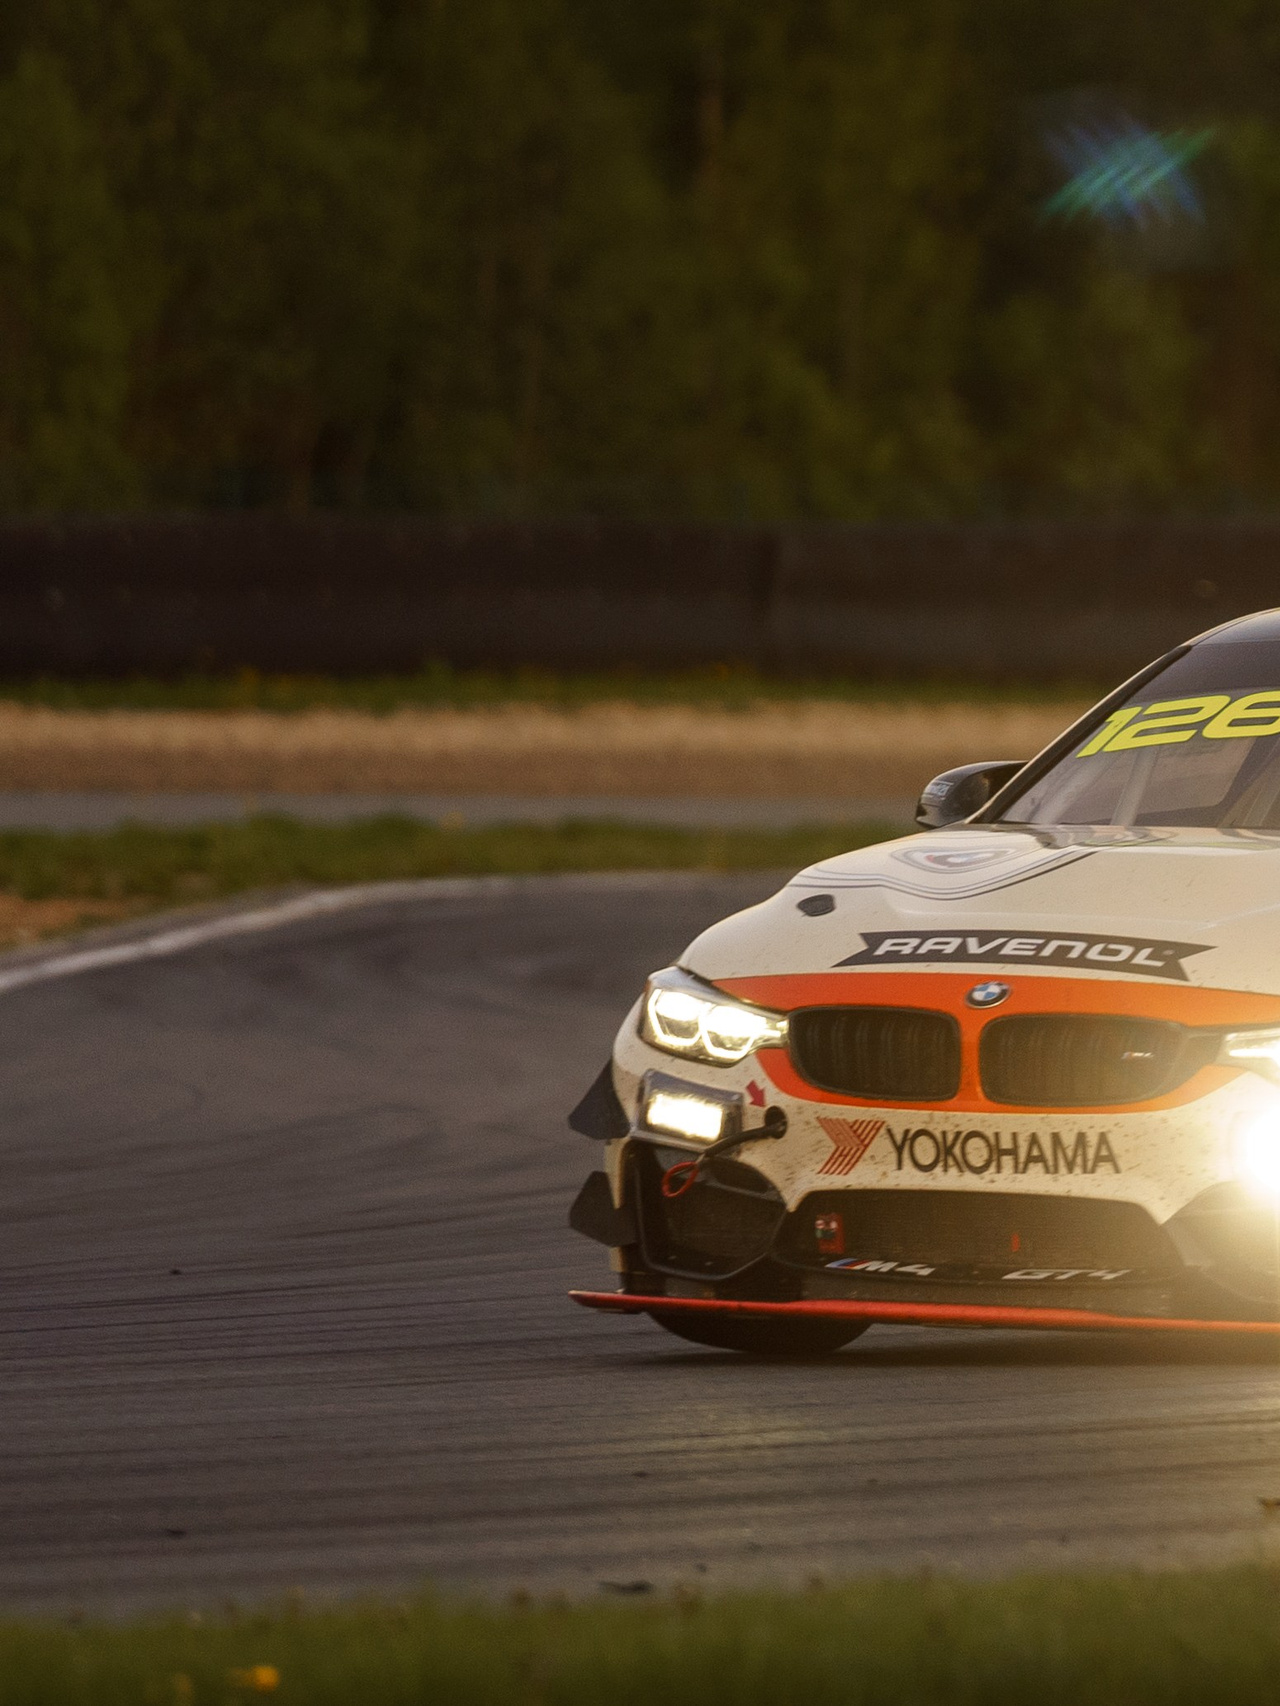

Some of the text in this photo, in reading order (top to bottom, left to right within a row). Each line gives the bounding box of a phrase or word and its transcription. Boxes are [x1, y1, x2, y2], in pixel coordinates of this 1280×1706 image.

[873, 937, 1168, 967] RAVENOL
[886, 1127, 1121, 1174] YOKOHAMA
[1002, 1268, 1131, 1280] GT4
